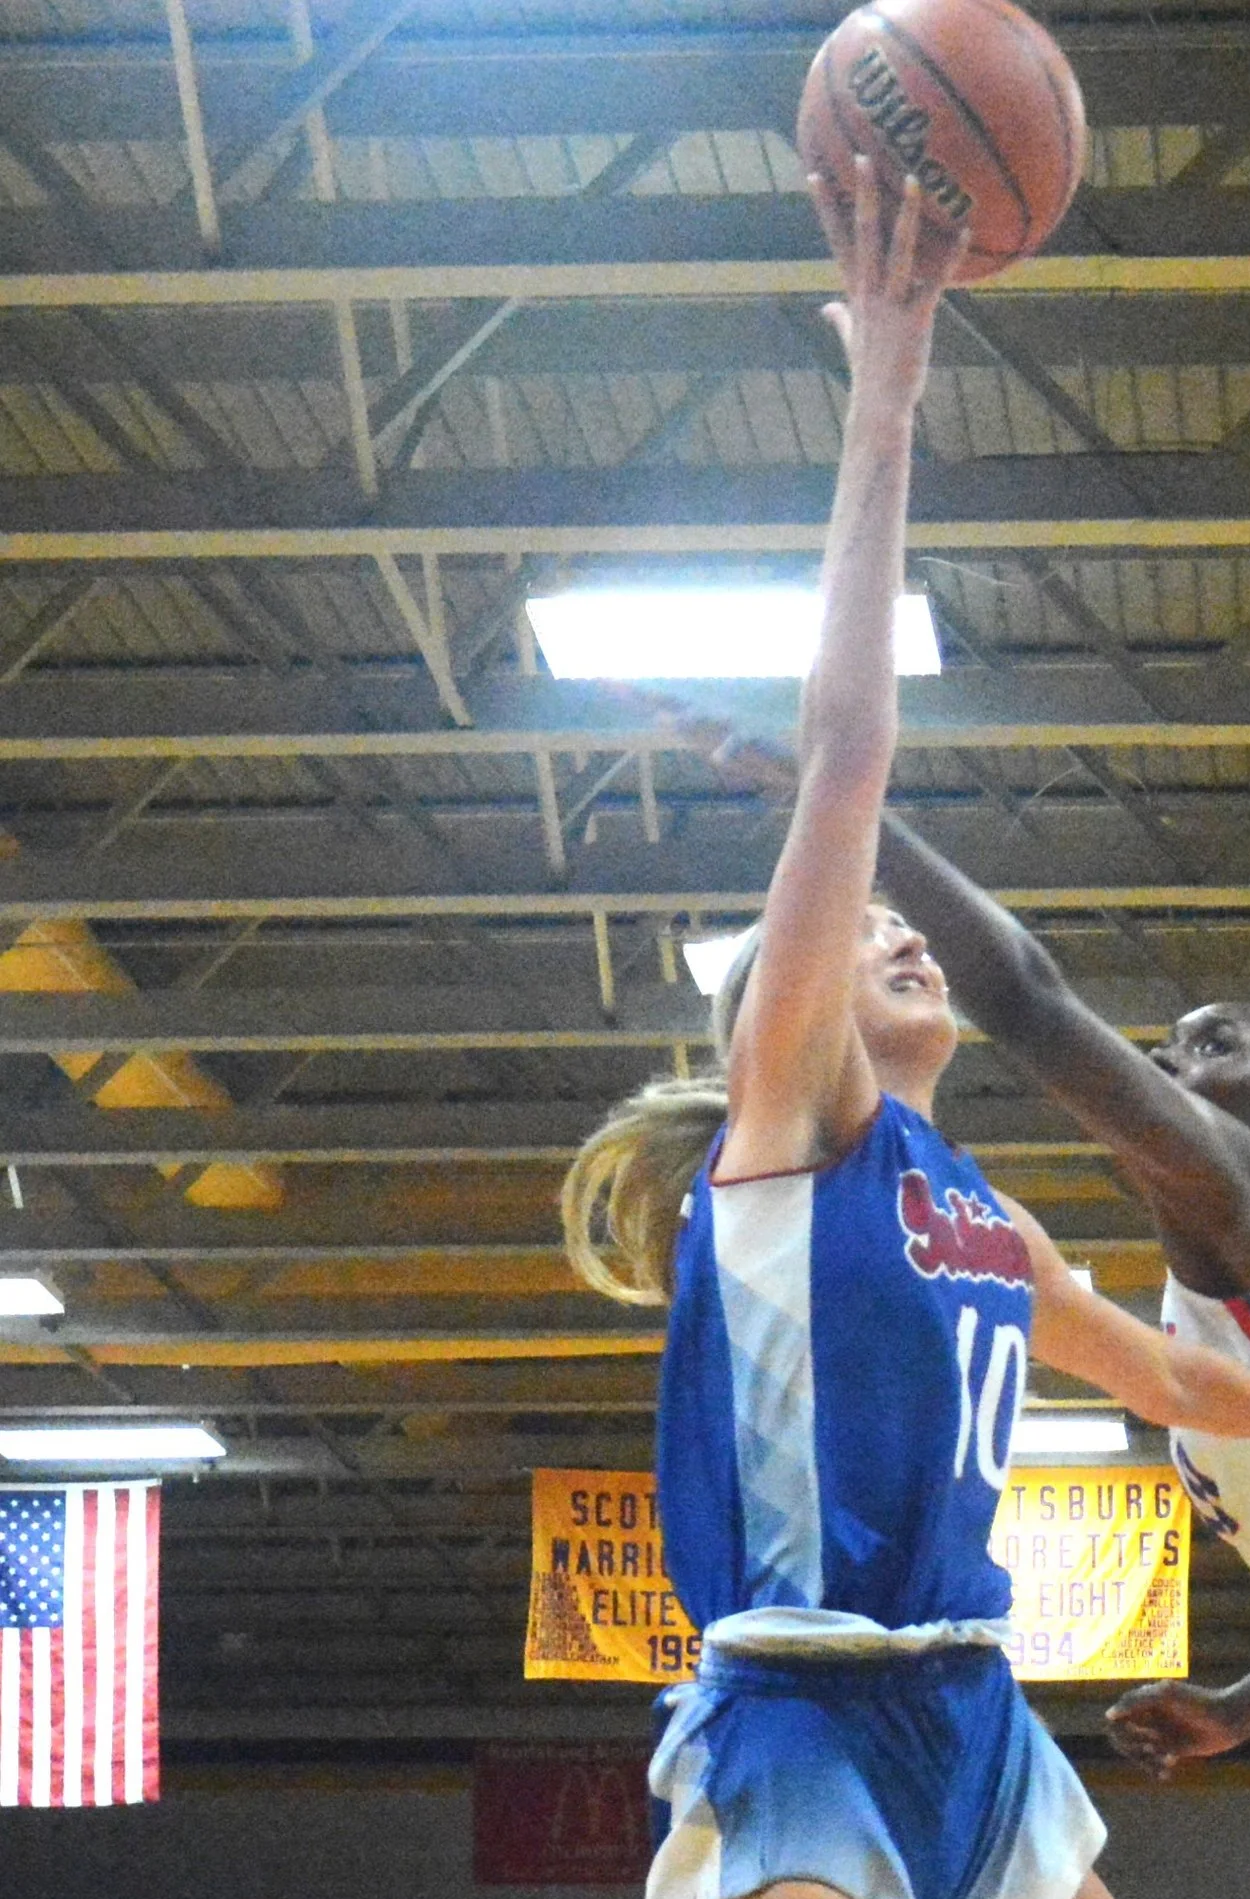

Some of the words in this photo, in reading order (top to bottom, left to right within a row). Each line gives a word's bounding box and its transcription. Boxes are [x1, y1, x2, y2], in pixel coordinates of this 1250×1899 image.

[954, 1305, 1027, 1491] 10
[1011, 1482, 1172, 1521] TSBURG
[1005, 1529, 1180, 1569] ORETTES
[592, 1589, 676, 1626] ELITE
[1039, 1581, 1126, 1617] EIGHT
[1010, 1632, 1074, 1666] 994
